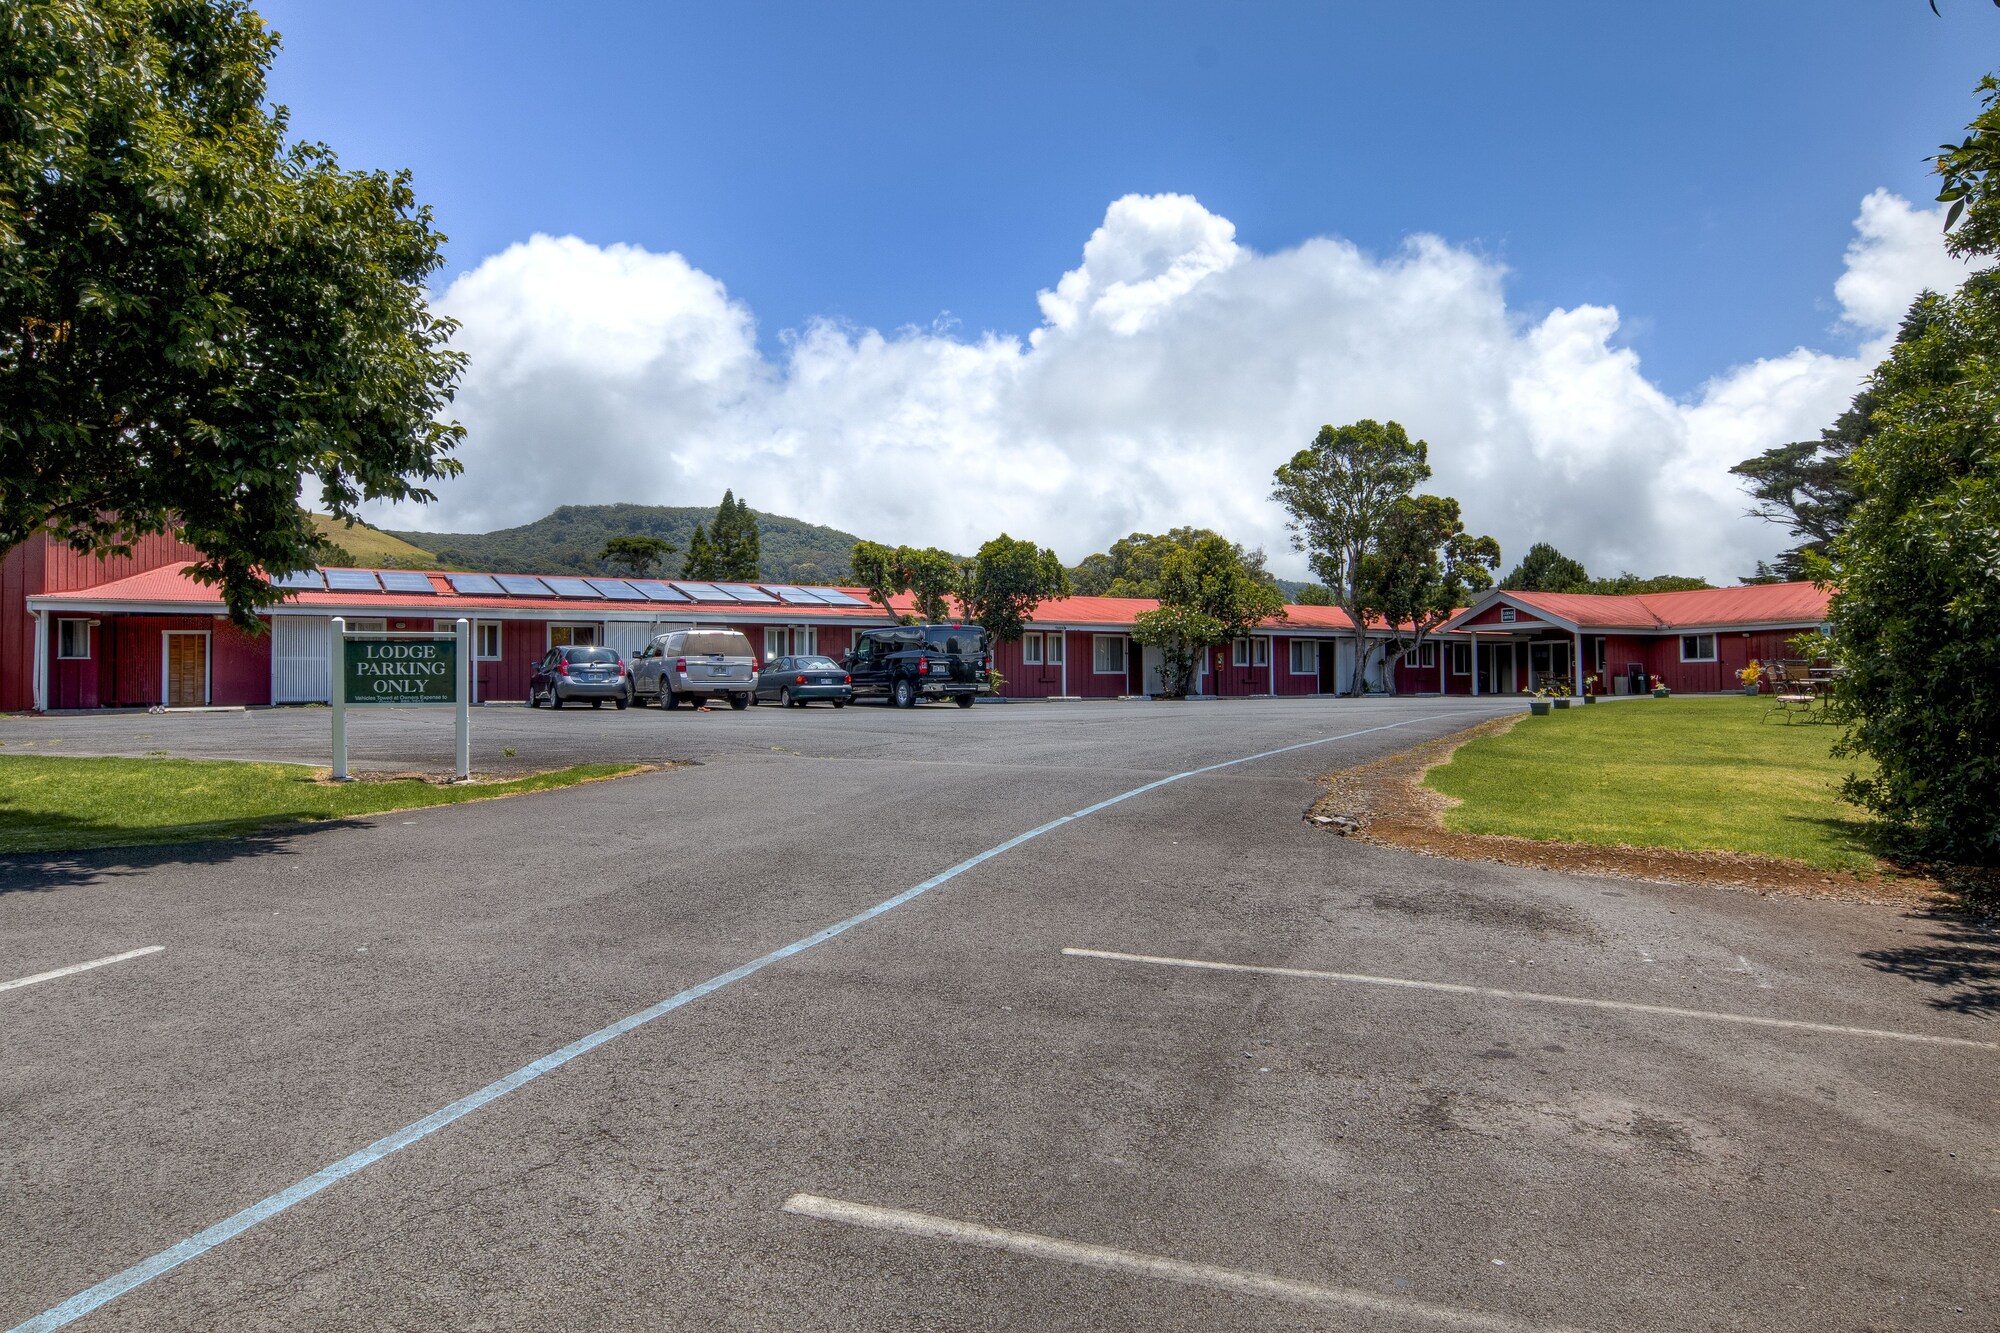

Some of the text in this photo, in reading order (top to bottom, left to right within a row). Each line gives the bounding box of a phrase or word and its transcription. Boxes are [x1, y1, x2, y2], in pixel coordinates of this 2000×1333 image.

[366, 645, 436, 658] LODGE
[356, 662, 446, 676] PARKING
[373, 680, 429, 692] ONLY
